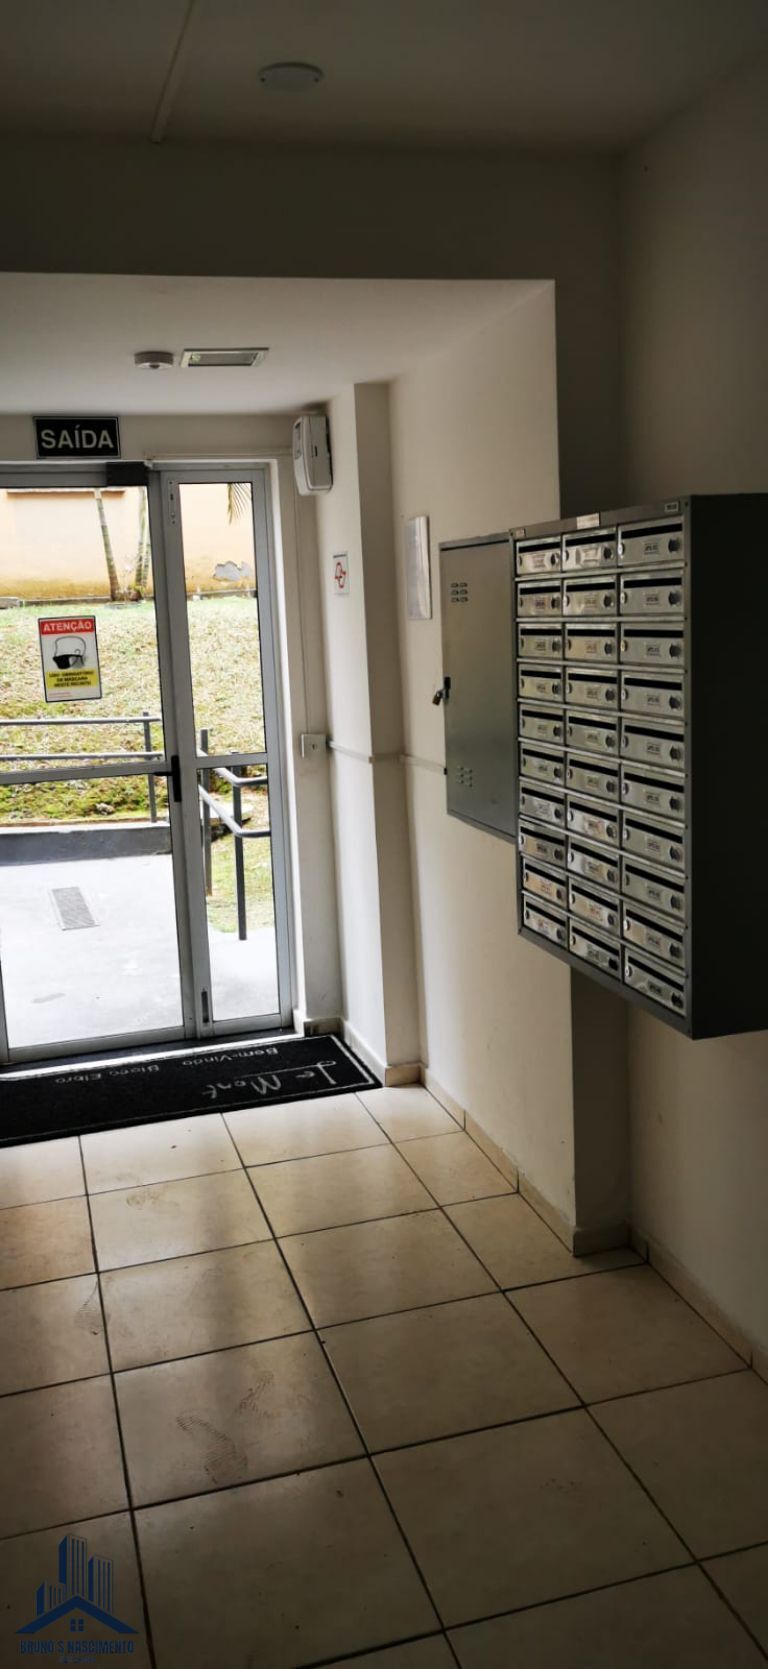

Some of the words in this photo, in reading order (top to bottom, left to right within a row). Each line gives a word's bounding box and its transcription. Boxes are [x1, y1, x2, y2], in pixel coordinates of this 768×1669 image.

[40, 424, 114, 449] SAÍDA
[42, 620, 92, 633] ATENÇÃO
[183, 1047, 278, 1066] Bem-Vindo
[201, 1075, 281, 1099] Mont
